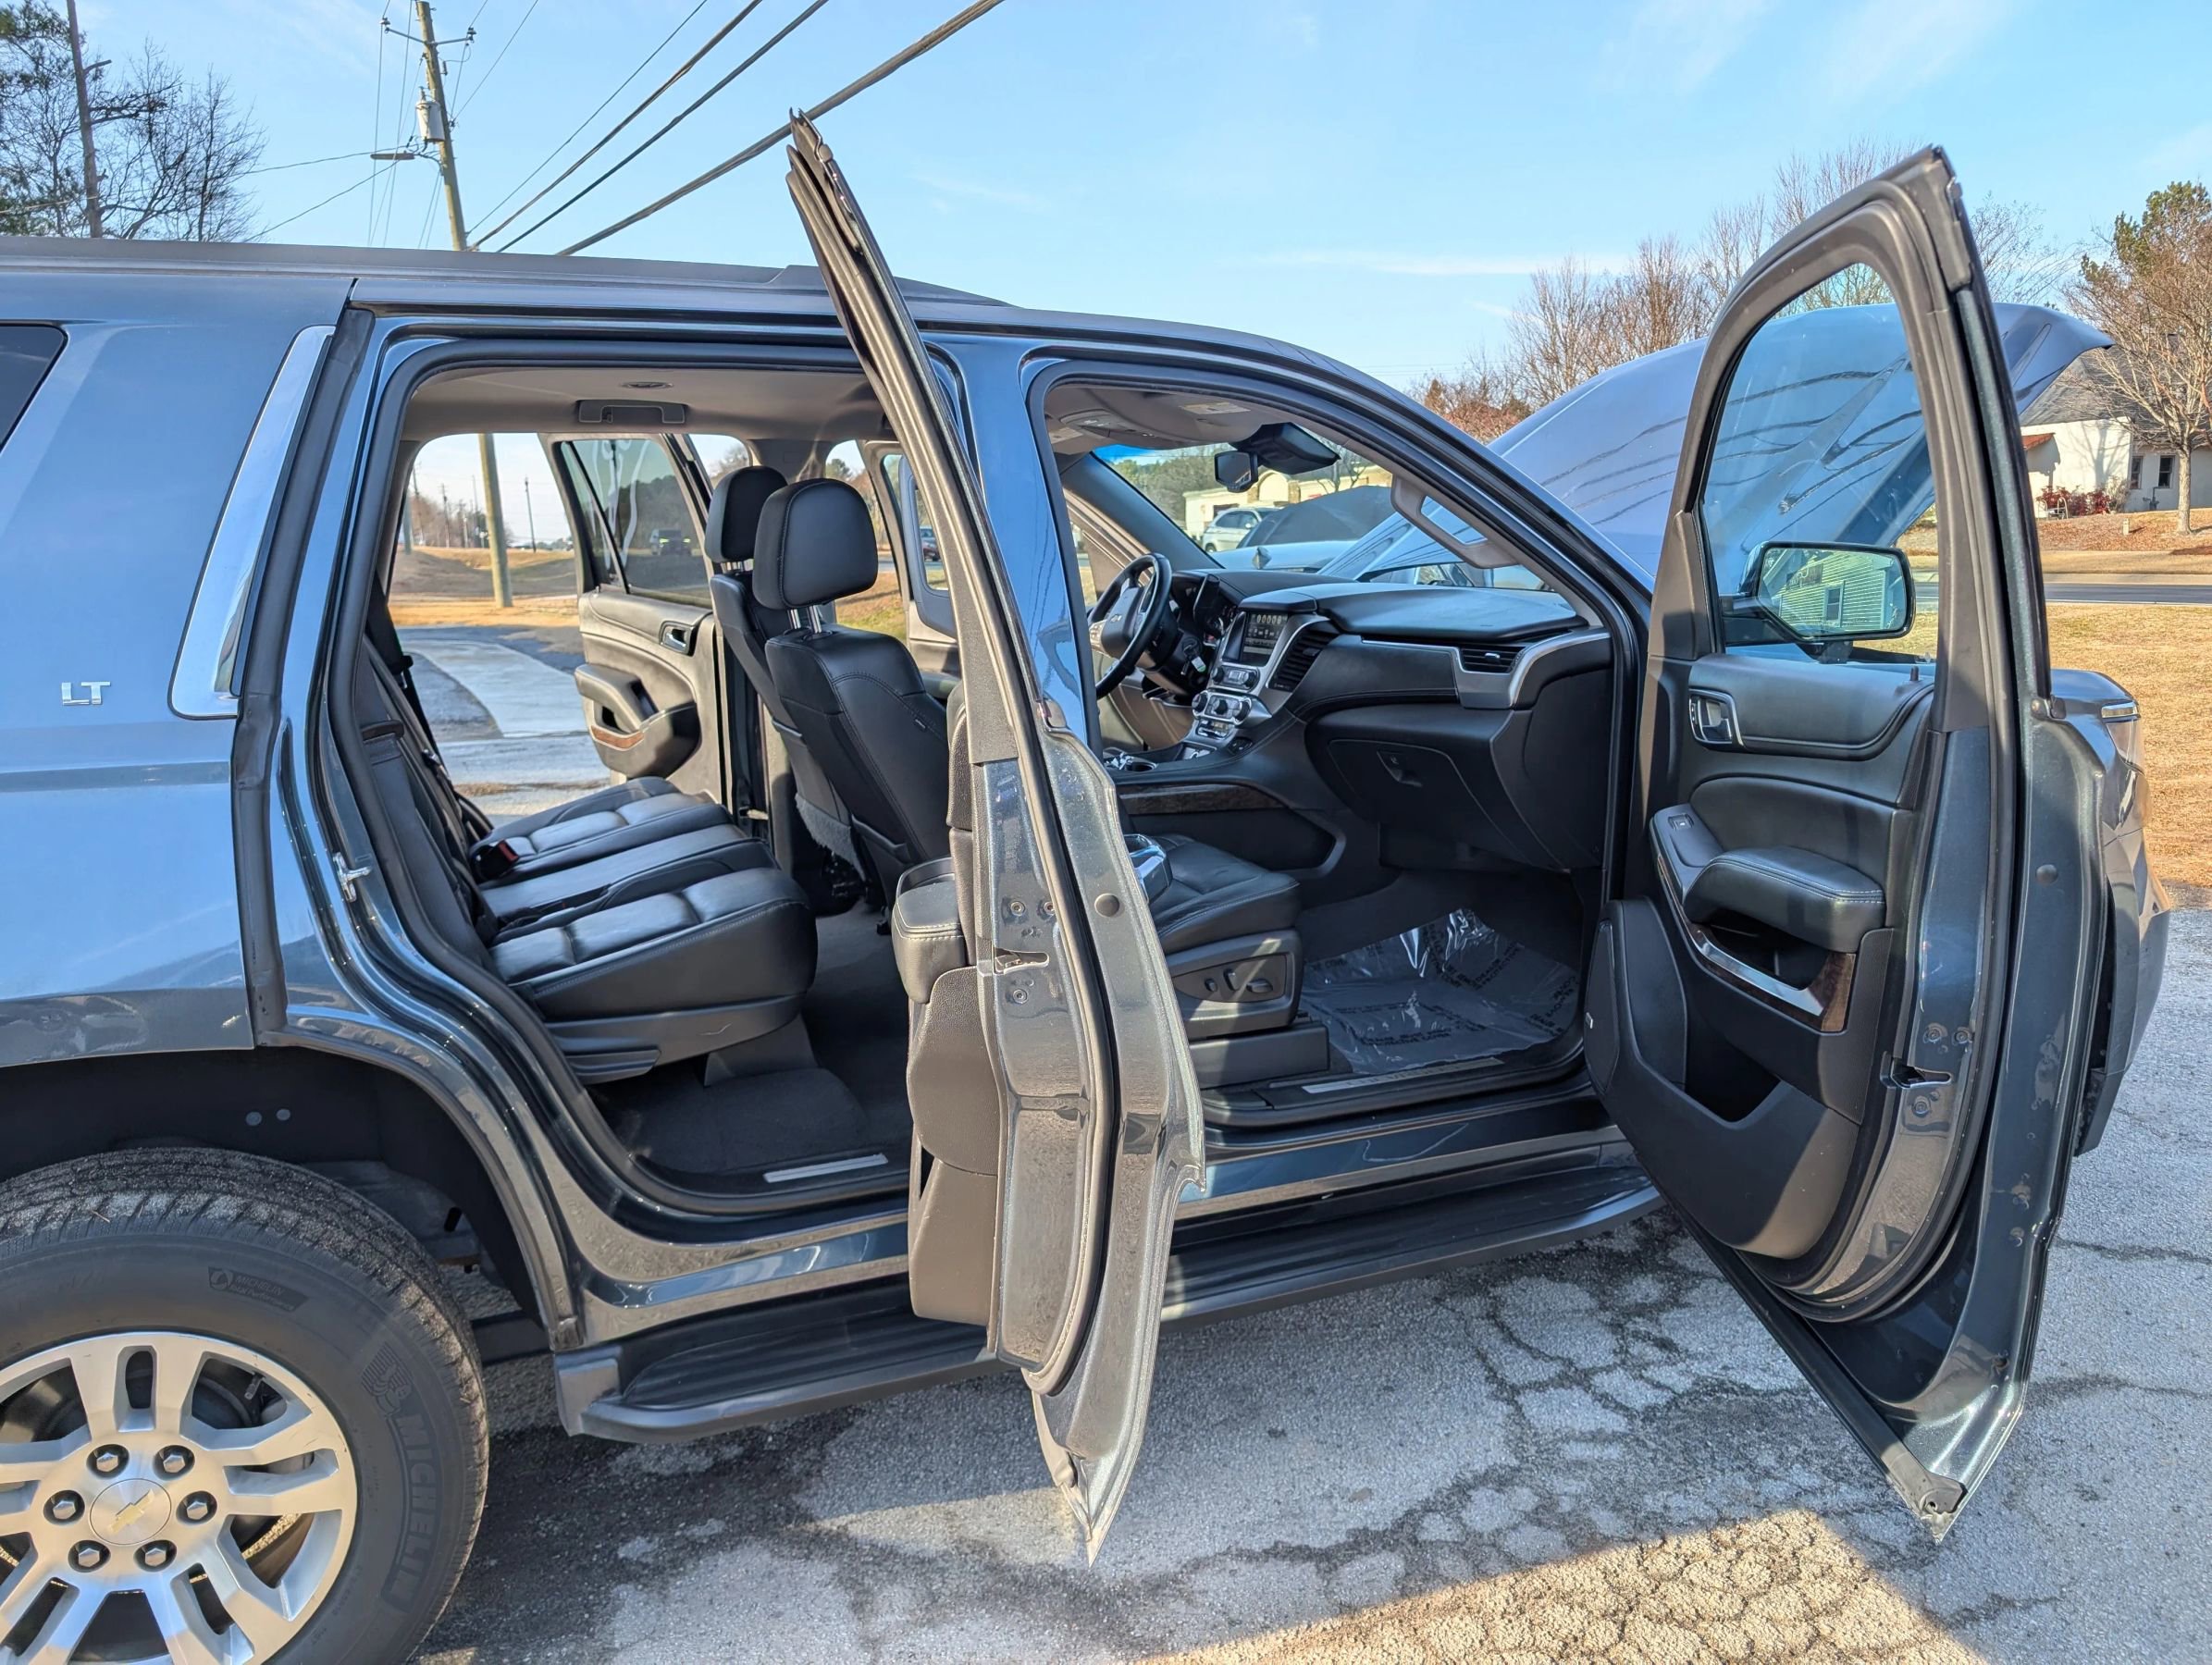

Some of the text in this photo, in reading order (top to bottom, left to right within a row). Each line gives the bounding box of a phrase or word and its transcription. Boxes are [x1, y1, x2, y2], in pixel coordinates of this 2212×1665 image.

[61, 681, 111, 705] LT
[236, 1274, 285, 1296] MICHELIN
[389, 1412, 439, 1608] MICHELIN
